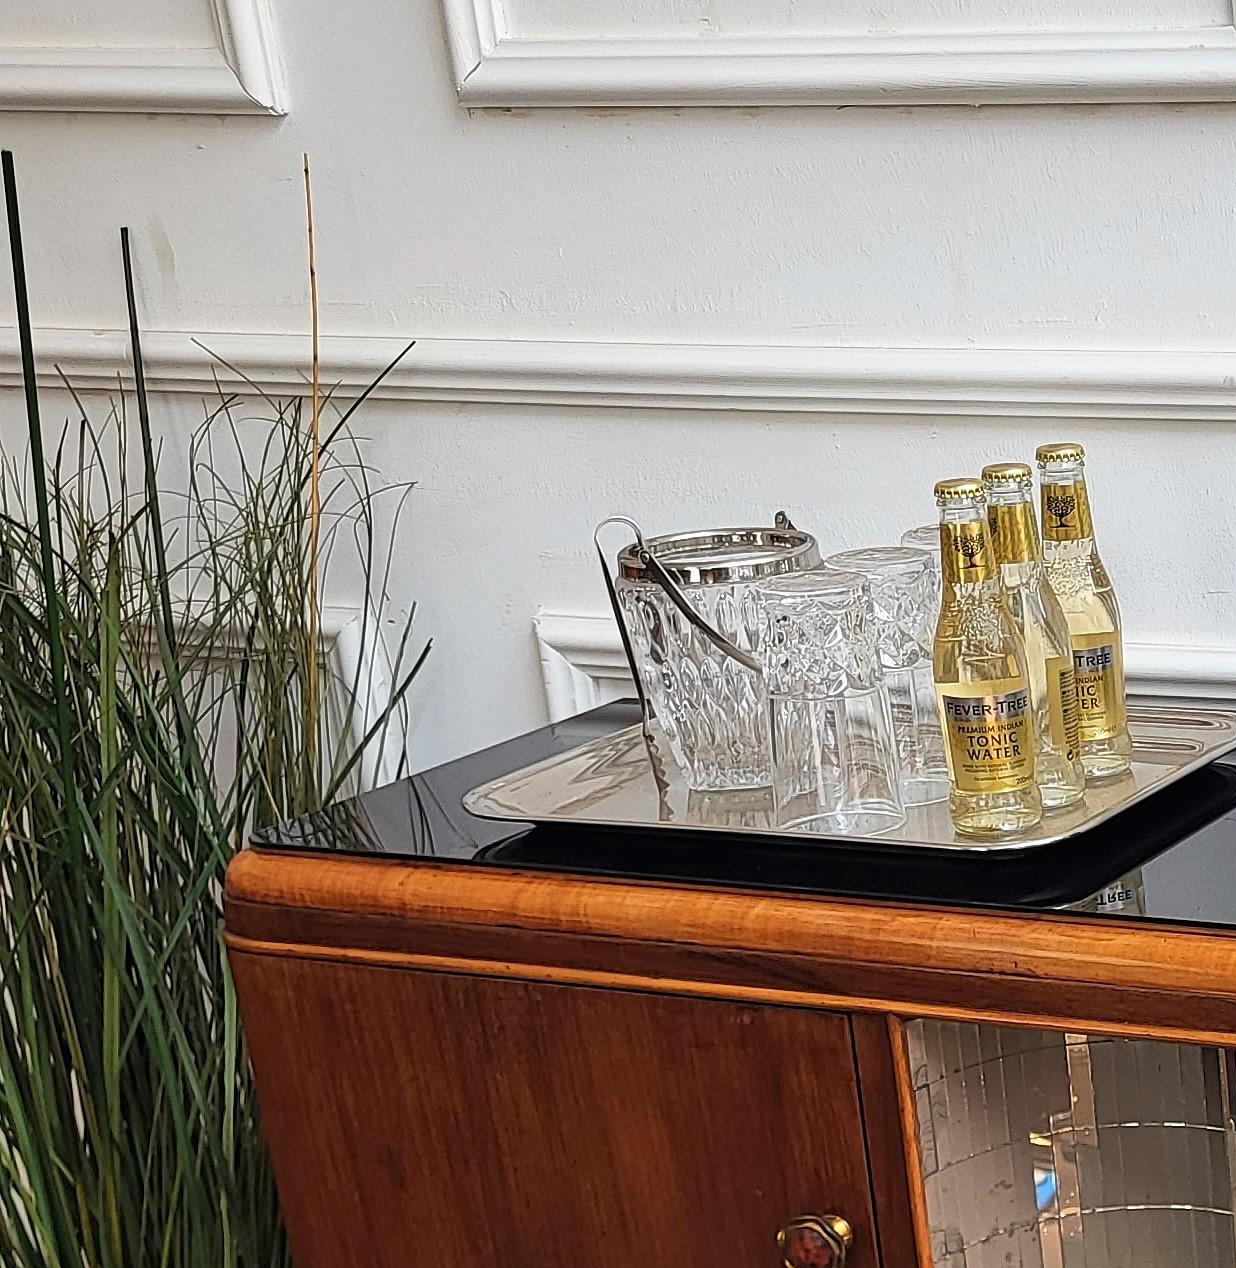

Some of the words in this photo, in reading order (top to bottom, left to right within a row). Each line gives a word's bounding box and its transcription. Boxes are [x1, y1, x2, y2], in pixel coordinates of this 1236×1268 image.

[947, 696, 1028, 716] FEVER-TREE
[957, 725, 995, 734] PREMIUM
[997, 720, 1024, 732] INDIAN
[966, 731, 1018, 748] TONIC
[966, 744, 1021, 761] WATER
